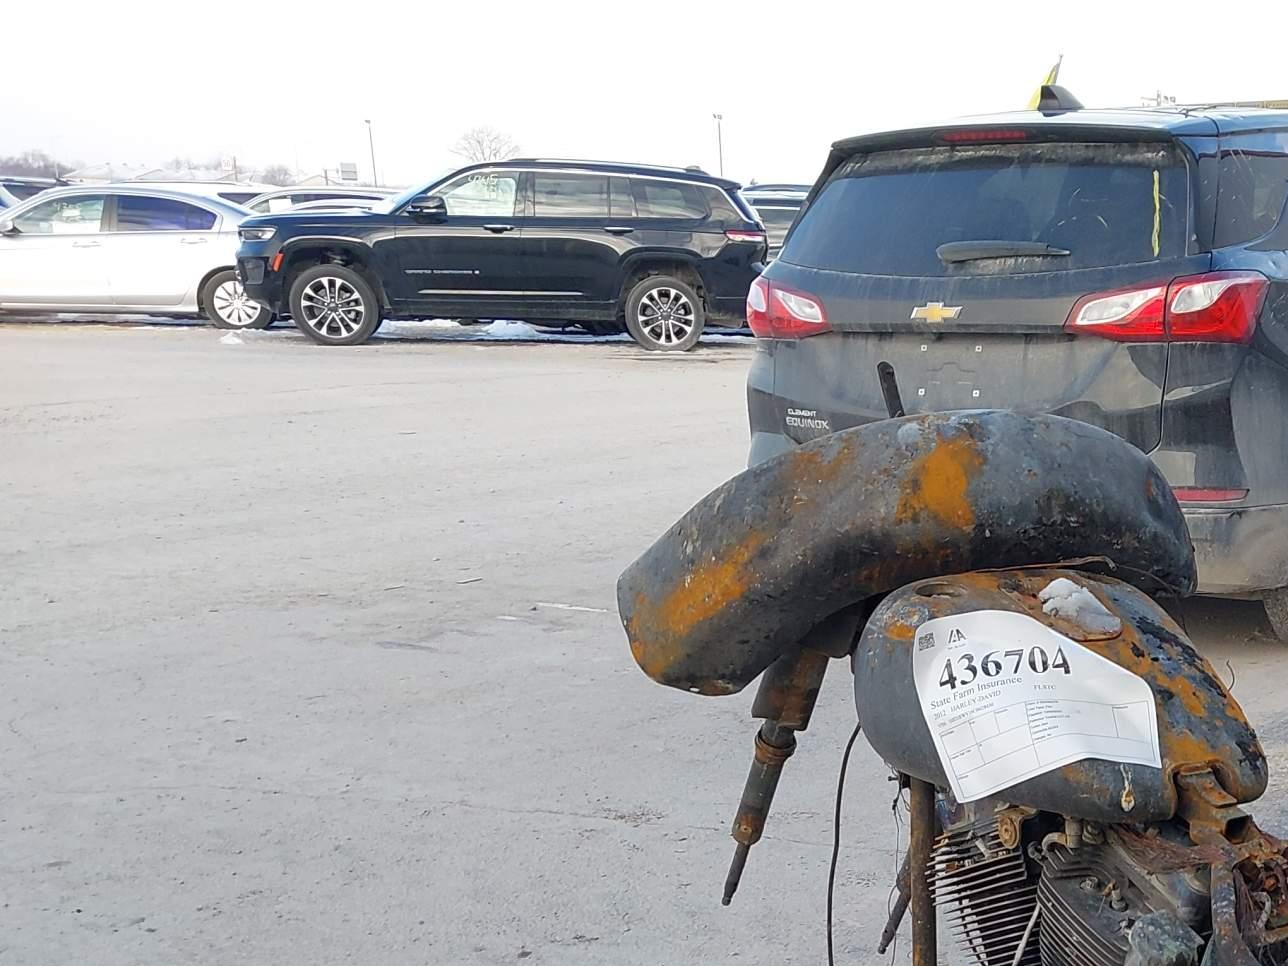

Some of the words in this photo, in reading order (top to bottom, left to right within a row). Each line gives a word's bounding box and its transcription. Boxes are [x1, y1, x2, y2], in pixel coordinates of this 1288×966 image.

[786, 416, 830, 430] EQUINOX
[939, 644, 1071, 690] 436704
[930, 697, 952, 710] State
[953, 687, 975, 701] Farm
[977, 676, 1022, 692] Insurance
